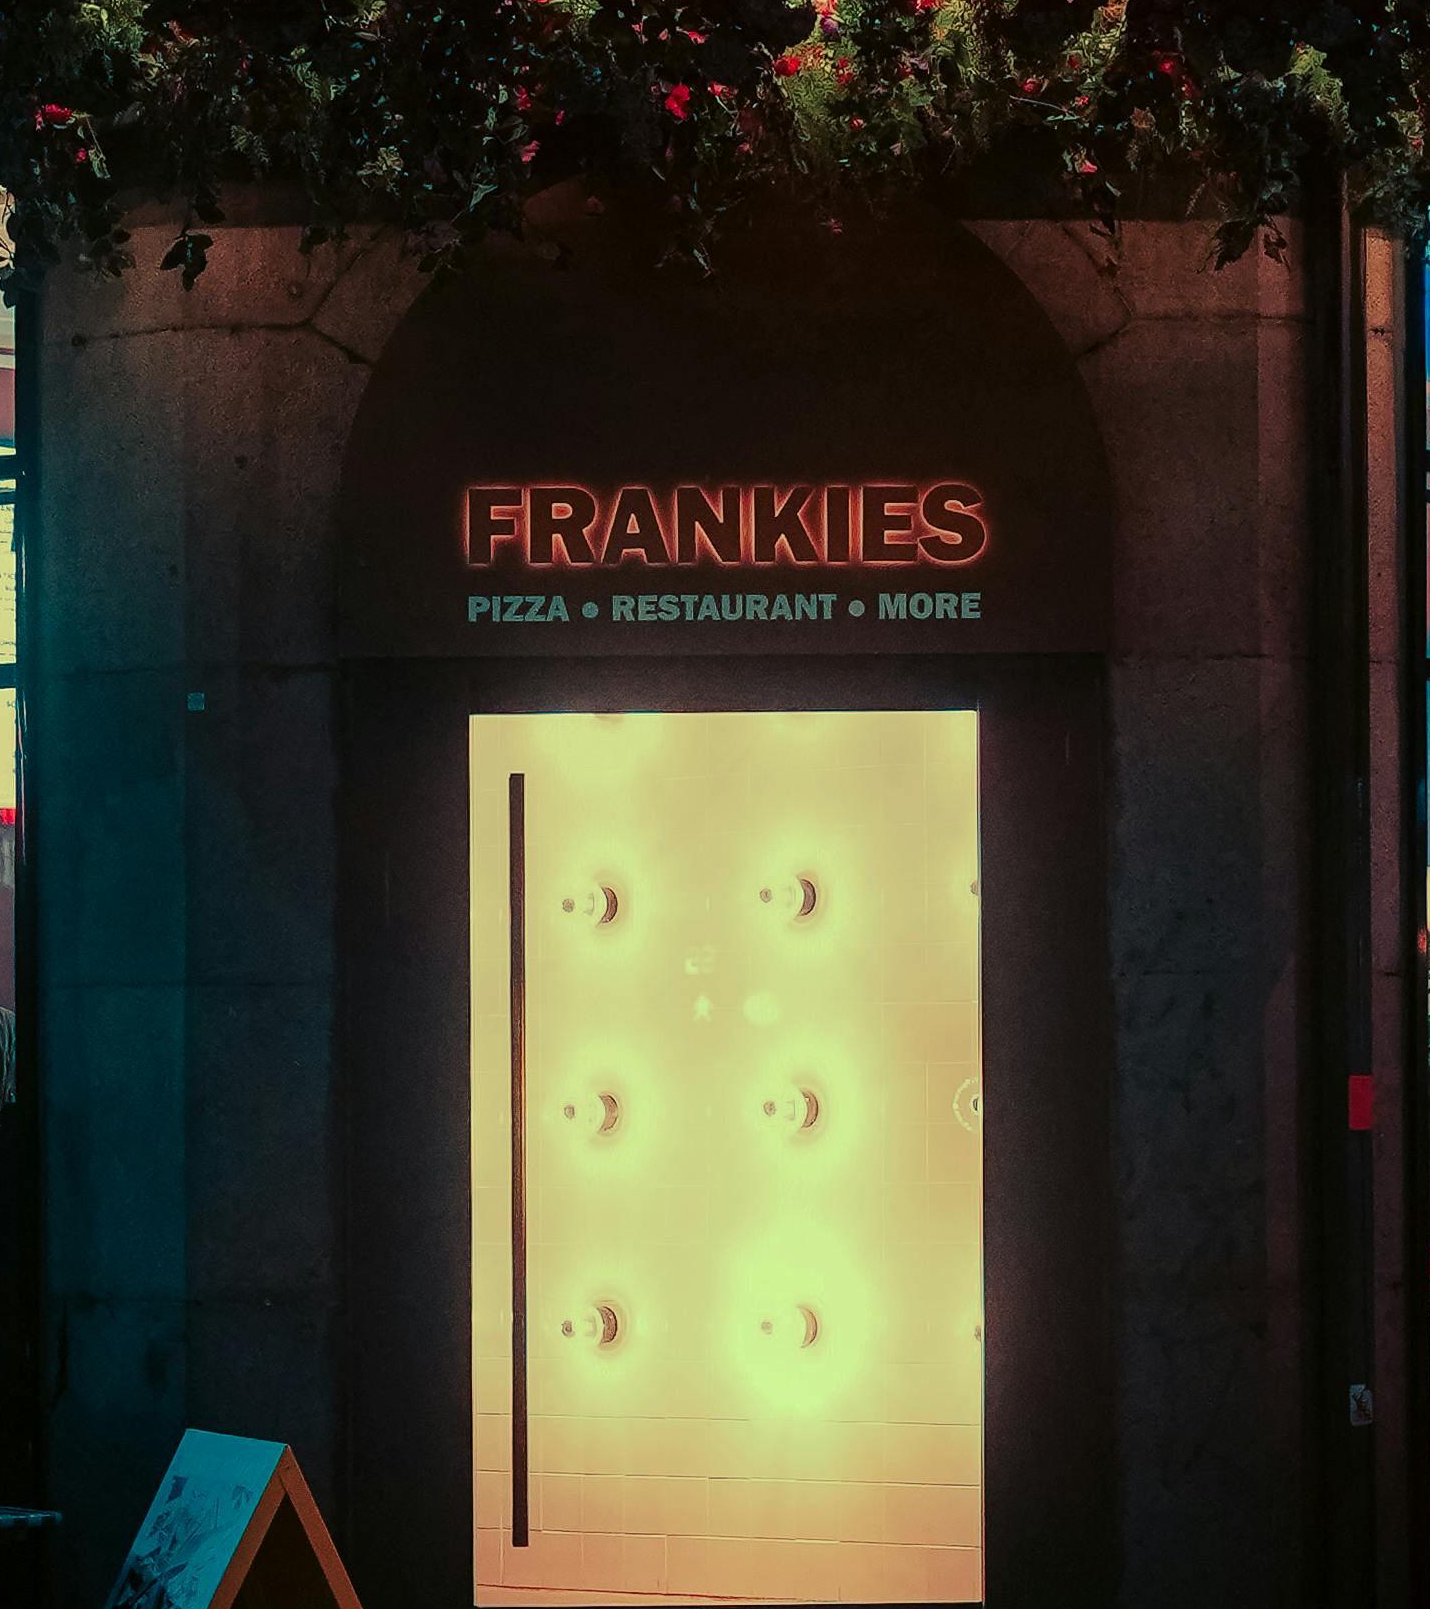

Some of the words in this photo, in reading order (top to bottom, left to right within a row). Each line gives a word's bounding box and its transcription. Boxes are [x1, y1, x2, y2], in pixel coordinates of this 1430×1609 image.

[467, 482, 989, 567] FRANKIES
[467, 594, 570, 622] PIZZA
[612, 592, 837, 621] RESTAURANT
[878, 591, 982, 620] MORE
